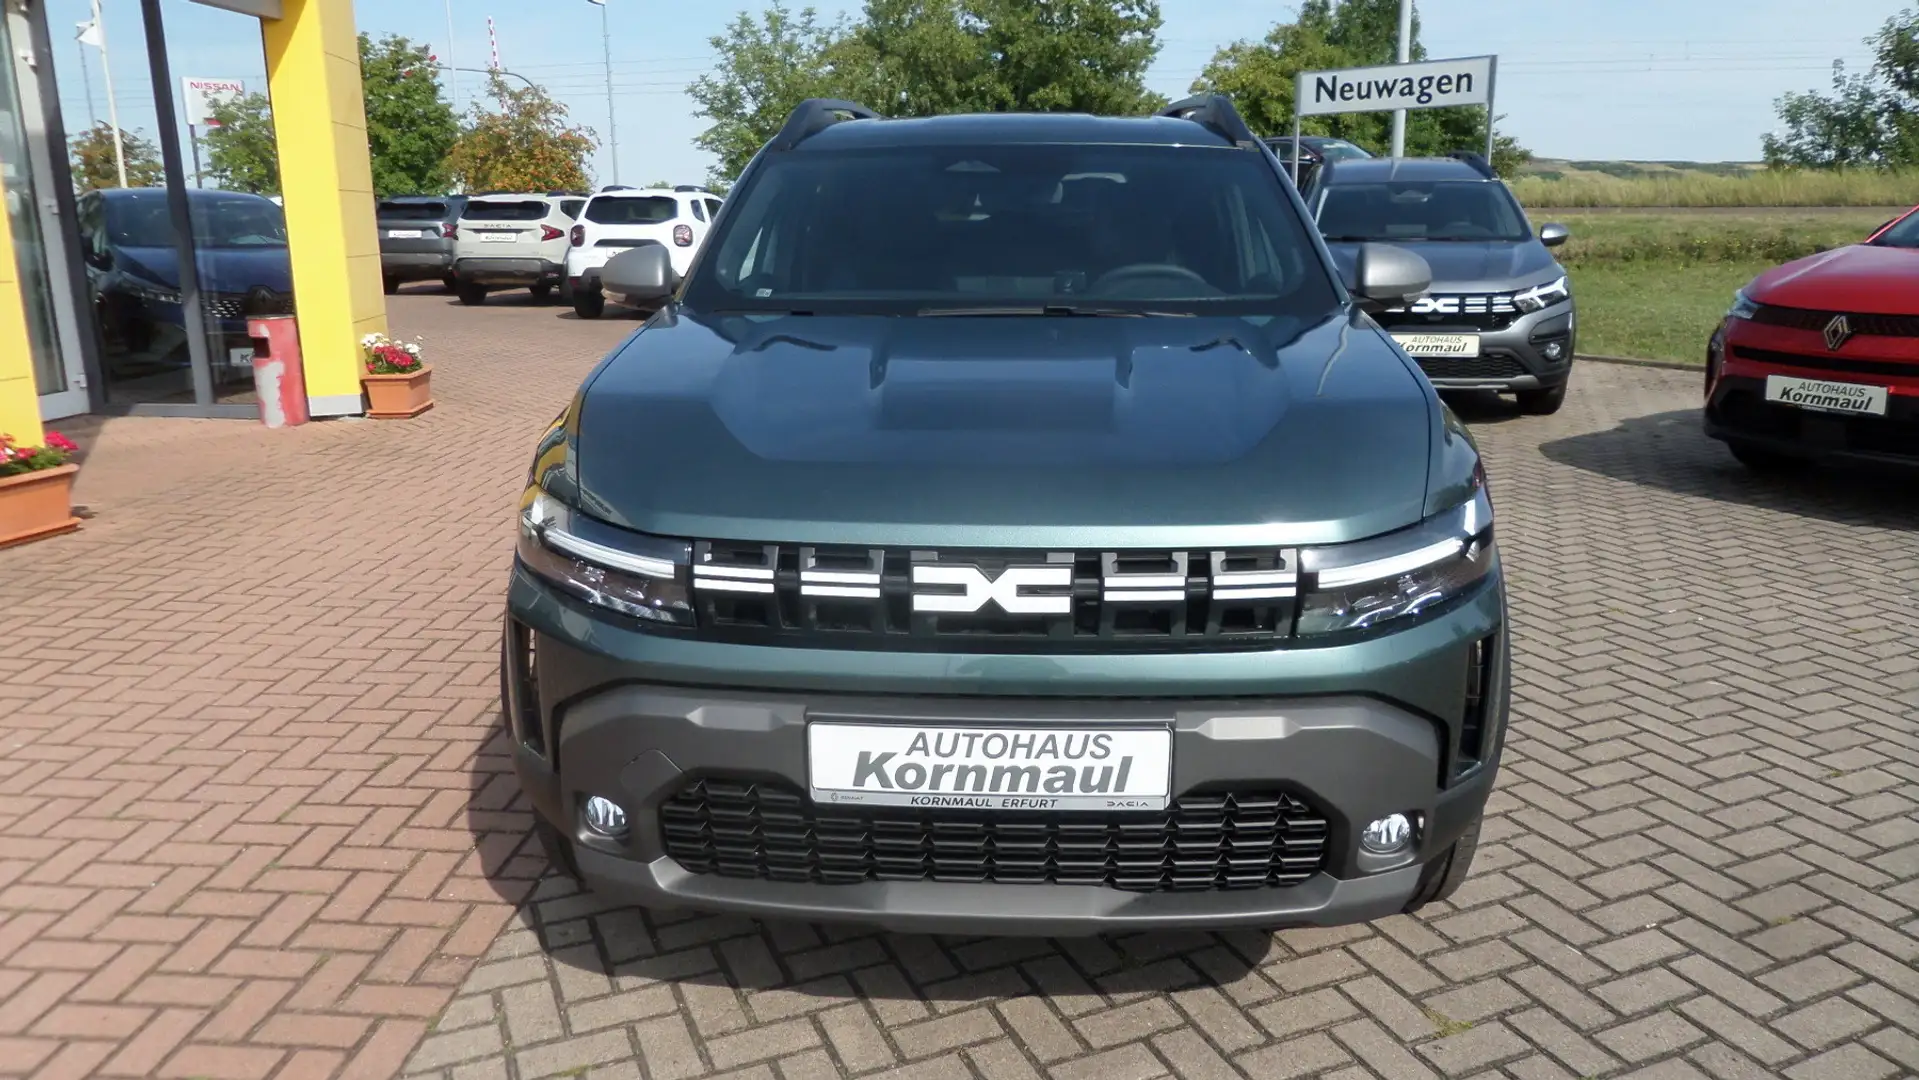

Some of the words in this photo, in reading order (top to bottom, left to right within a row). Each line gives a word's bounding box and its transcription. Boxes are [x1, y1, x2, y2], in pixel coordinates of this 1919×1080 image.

[190, 81, 240, 91] NISSAN
[1315, 72, 1473, 104] Neuwagen
[1412, 336, 1463, 344] AUTOHAUS
[1780, 387, 1874, 410] Kornmaul
[1798, 381, 1866, 397] AUTOHAUS
[905, 732, 1113, 760] AUTOHAUS
[852, 751, 1133, 794] Kornmaul
[910, 796, 993, 808] KORNMAUL
[1001, 798, 1059, 809] ERFURT
